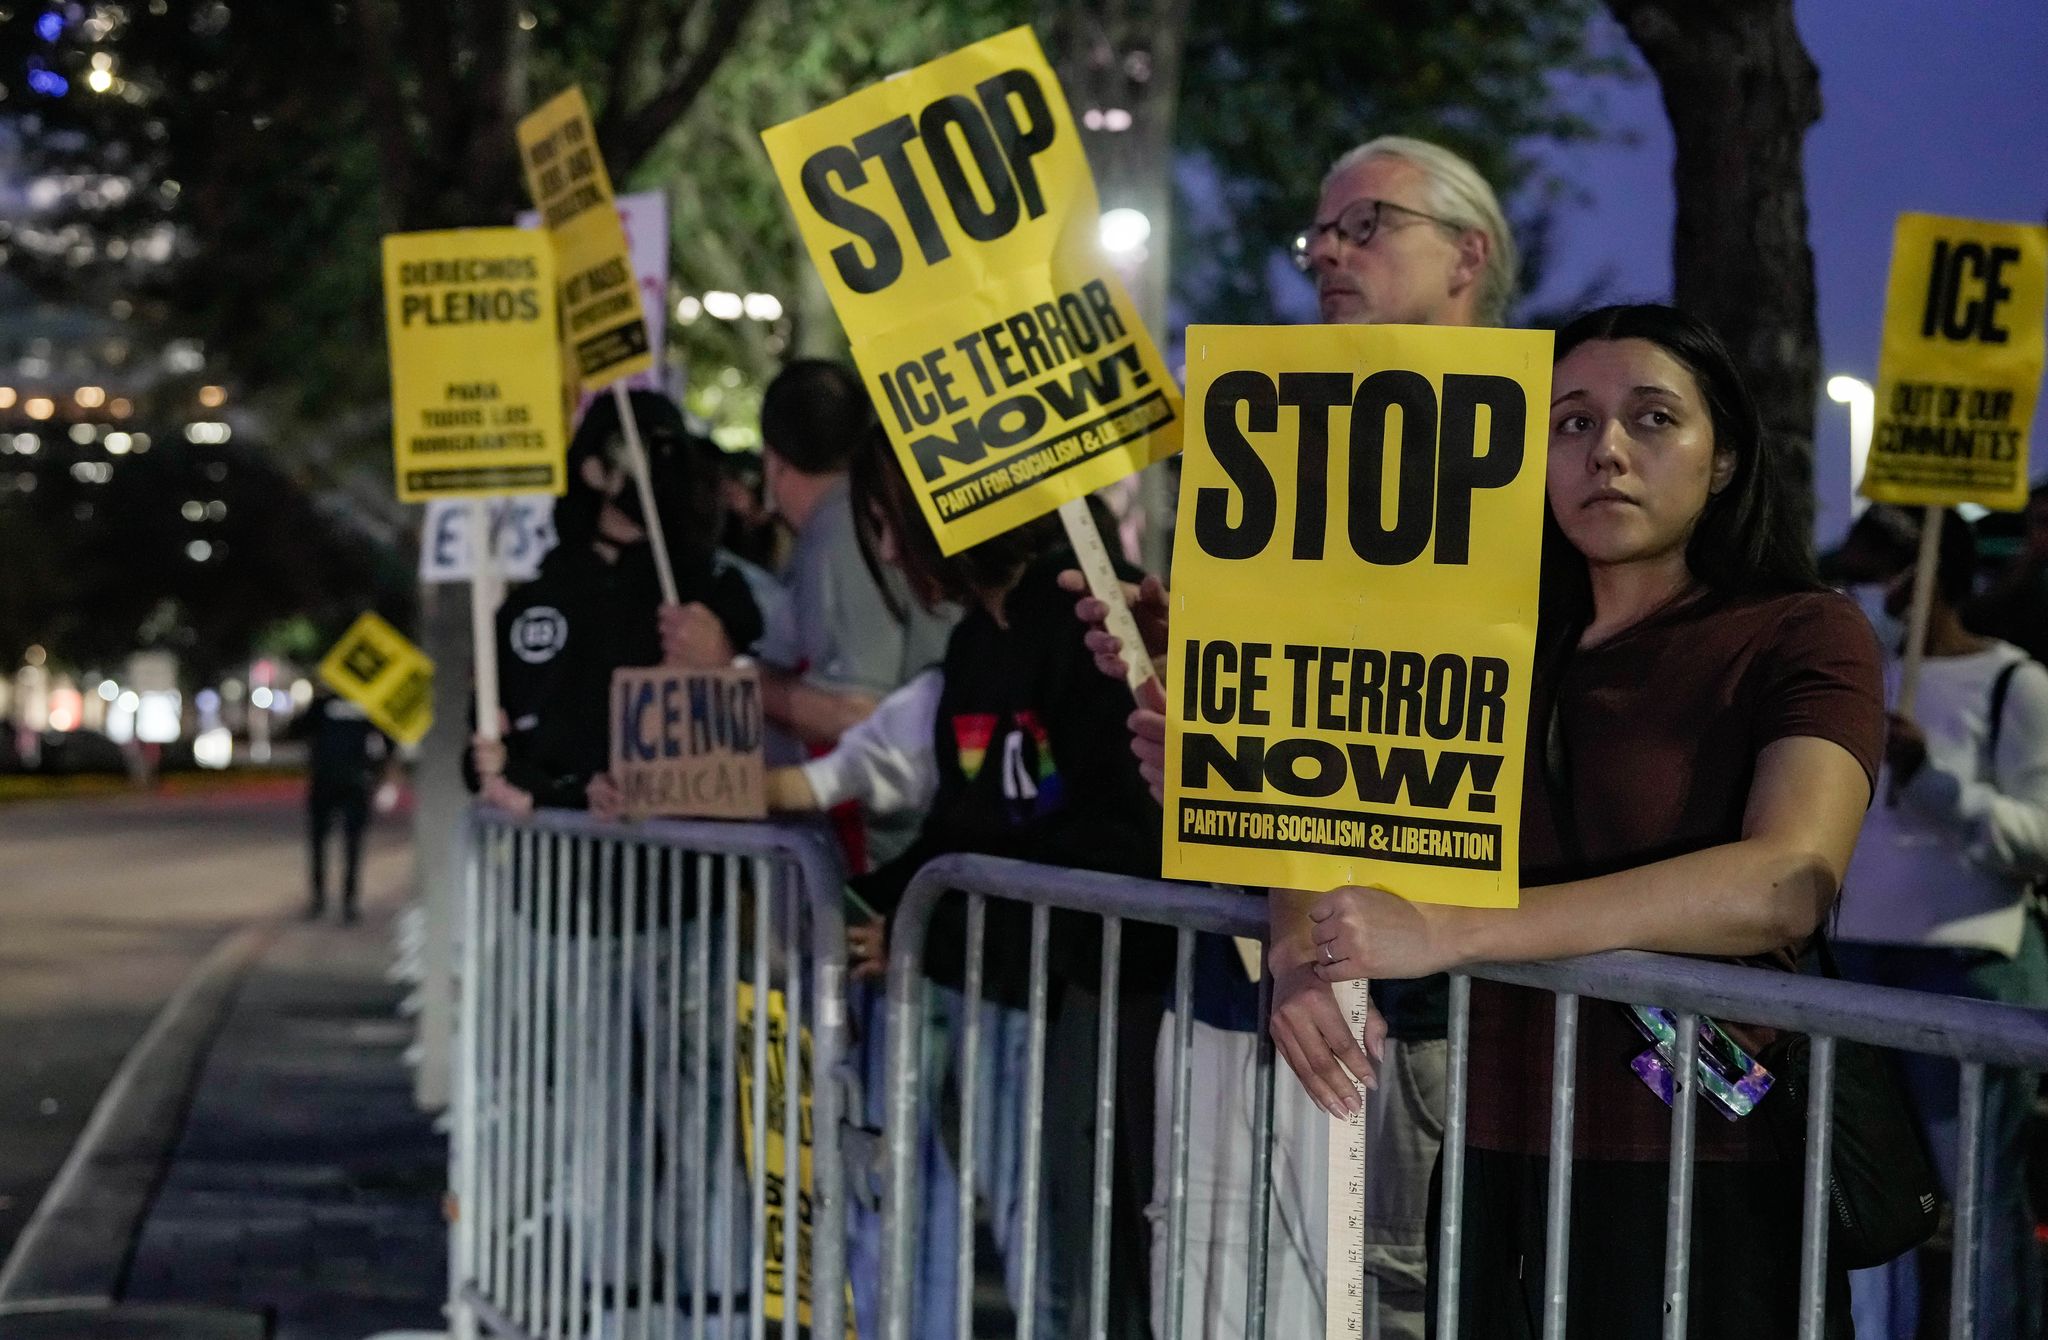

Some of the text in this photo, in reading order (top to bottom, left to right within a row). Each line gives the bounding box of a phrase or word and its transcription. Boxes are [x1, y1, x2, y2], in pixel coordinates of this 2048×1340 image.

[801, 68, 1056, 294] STOP
[400, 257, 537, 287] DERECHOS
[403, 291, 539, 327] PLENOS
[1921, 239, 2021, 344] ICE
[878, 279, 1128, 435] ICE TERROR
[910, 343, 1152, 483] NOW!
[936, 483, 983, 517] PARTY
[983, 468, 1013, 498] FOR
[1010, 437, 1082, 483] SOCIALISM
[1081, 430, 1100, 453] &
[1195, 370, 1527, 566] STOP
[1183, 639, 1510, 744] ICE TERROR
[1181, 733, 1505, 814] NOW!
[1184, 807, 1494, 861] PARTY FOR SOCIALISM & LIBERATION
[1351, 1010, 1360, 1022] 20
[1350, 1113, 1359, 1125] 23
[1349, 1147, 1358, 1160] 24
[1349, 1181, 1358, 1193] 25
[1348, 1215, 1357, 1227] 26
[1348, 1249, 1357, 1262] 27
[1347, 1283, 1356, 1296] 28
[1347, 1317, 1356, 1330] 29
